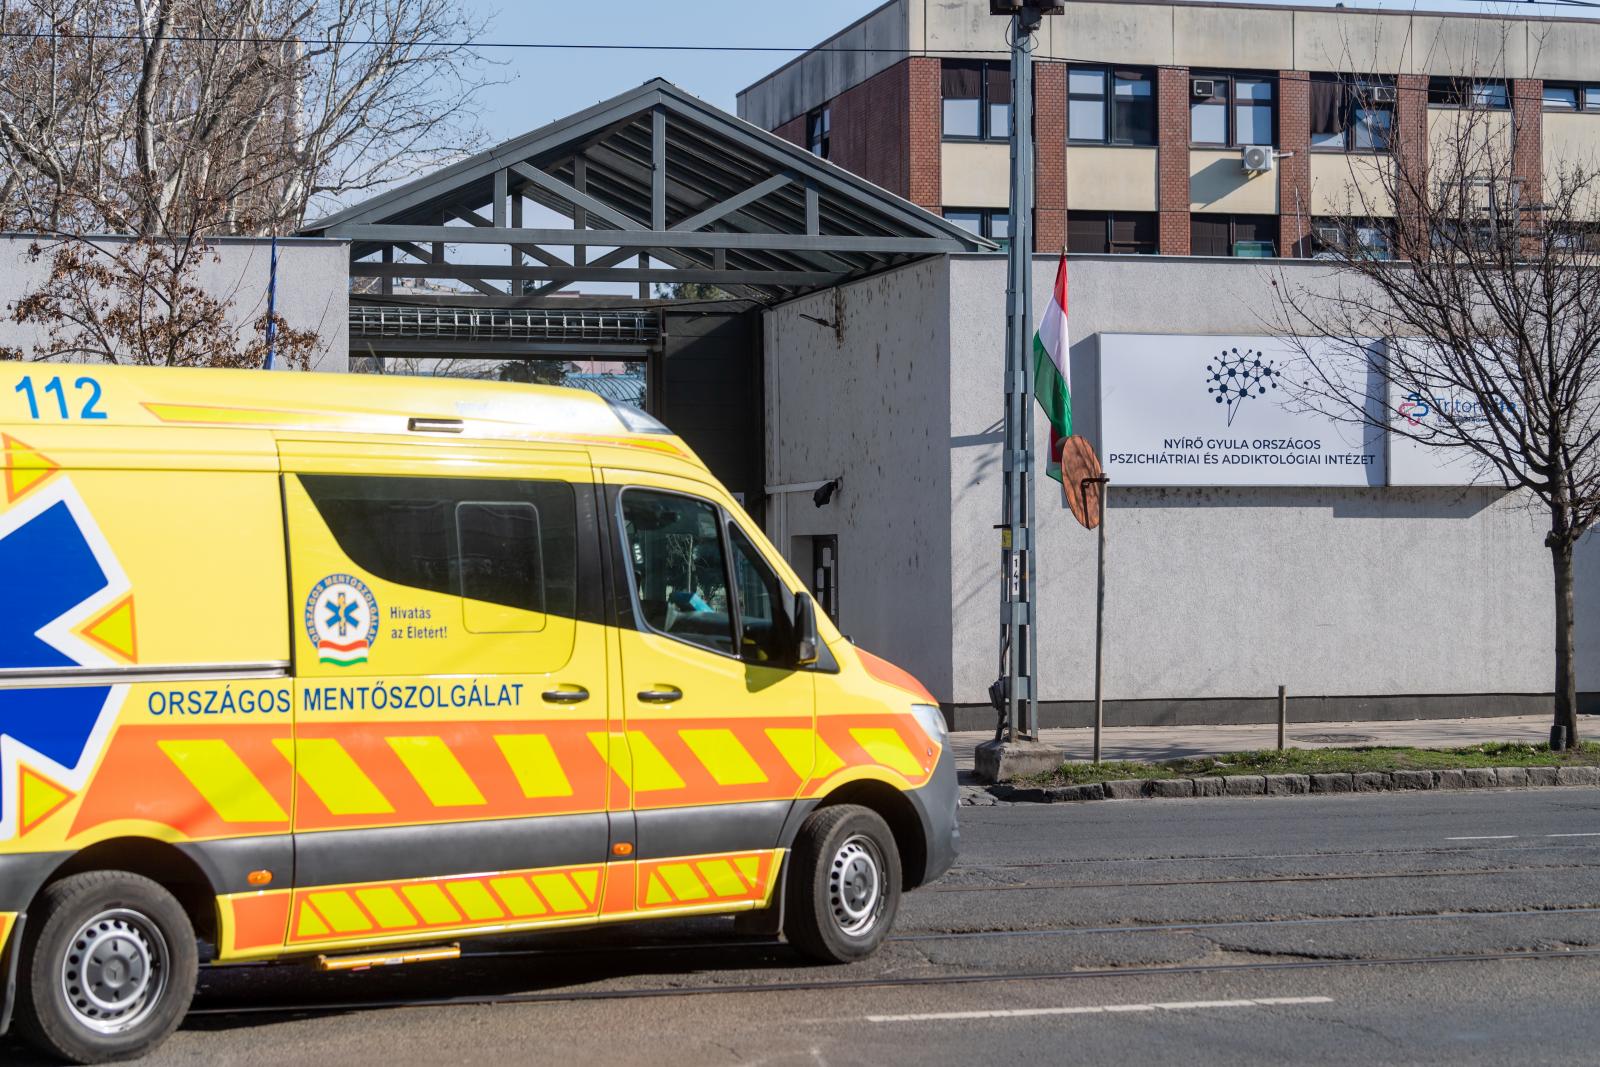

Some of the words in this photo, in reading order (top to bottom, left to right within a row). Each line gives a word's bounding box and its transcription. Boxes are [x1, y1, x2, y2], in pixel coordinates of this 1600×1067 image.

[15, 375, 108, 420] 112
[1164, 436, 1204, 450] NYÍRŐ
[1207, 438, 1249, 450] GYULA
[1252, 437, 1321, 450] ORSZÁGOS
[1109, 452, 1200, 465] PSZICHIÁTRIAI
[1203, 452, 1219, 465] ÉS
[1222, 452, 1321, 465] ADDIKTOLÓGIAI
[1325, 452, 1376, 465] INTÉZET
[391, 628, 403, 639] az
[148, 684, 291, 716] ORSZÁGOS
[303, 679, 524, 711] MENTŐSZOLGÁLAT
